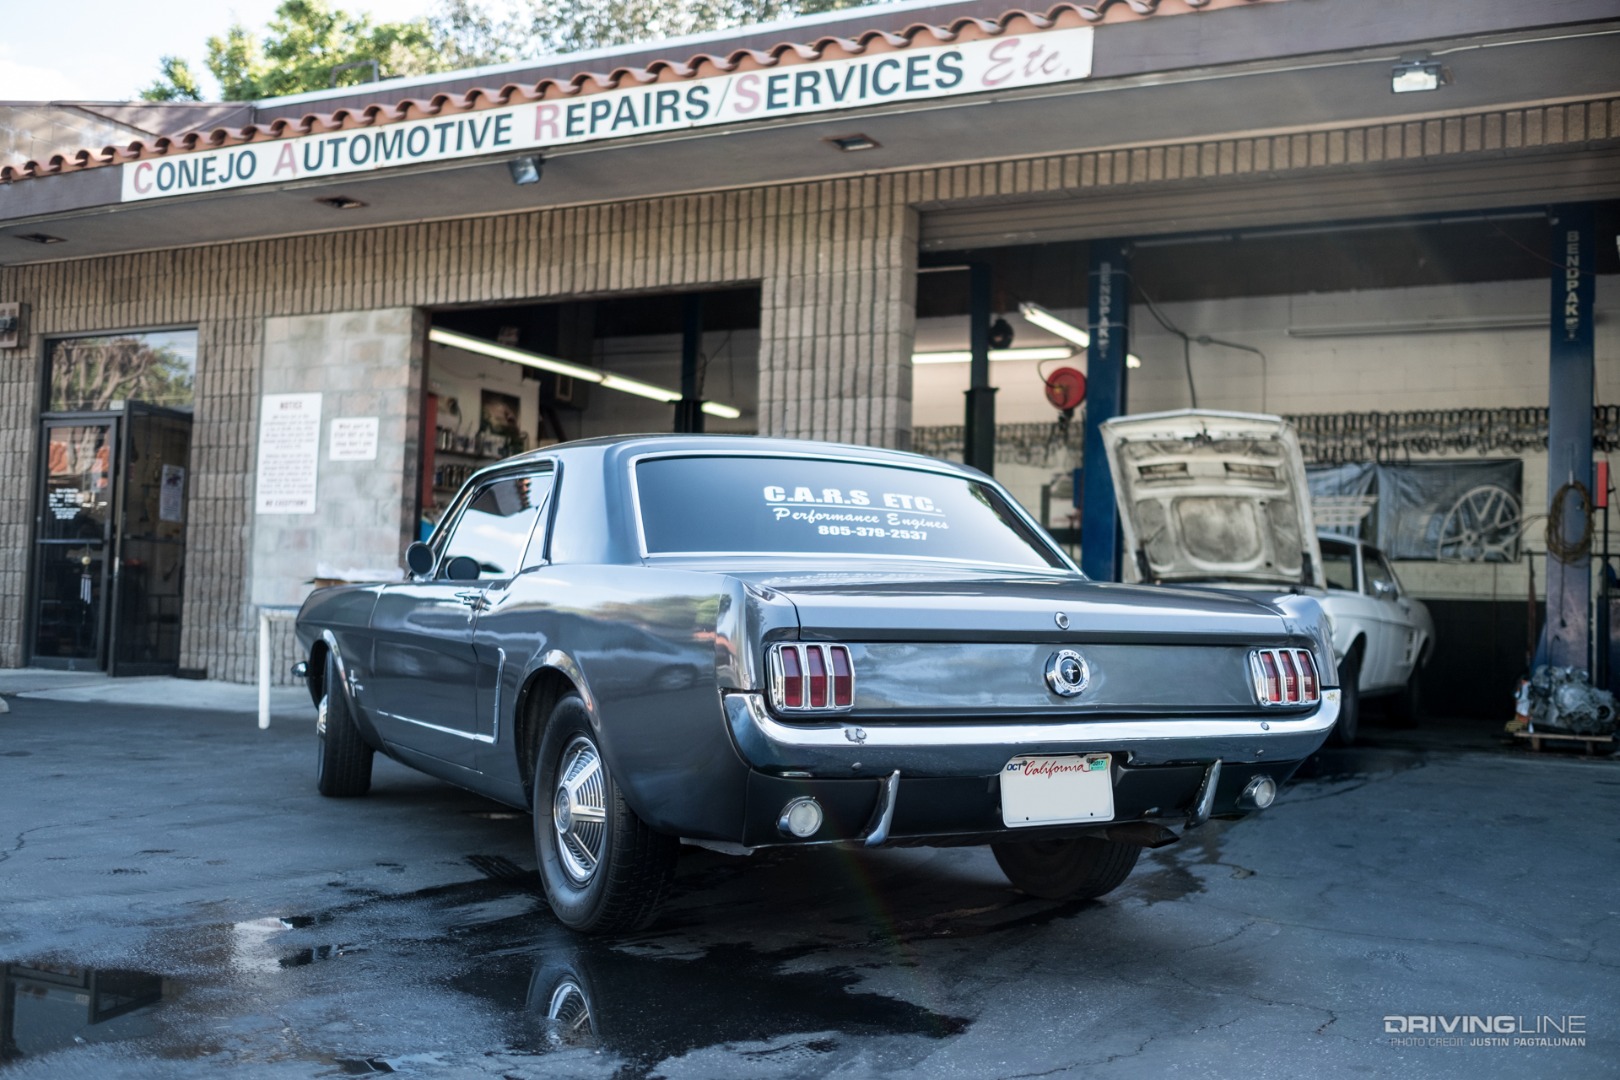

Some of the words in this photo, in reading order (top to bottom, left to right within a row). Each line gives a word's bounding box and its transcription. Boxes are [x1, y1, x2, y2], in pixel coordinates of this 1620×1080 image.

[133, 150, 257, 194] CONEJO
[273, 113, 513, 177] AUTOMOTIVE
[882, 492, 943, 513] ETC.
[772, 507, 880, 524] Performance
[886, 512, 949, 530] Engines
[818, 525, 928, 541] 805-379-2537
[1006, 763, 1022, 771] OCT
[1024, 760, 1091, 779] California
